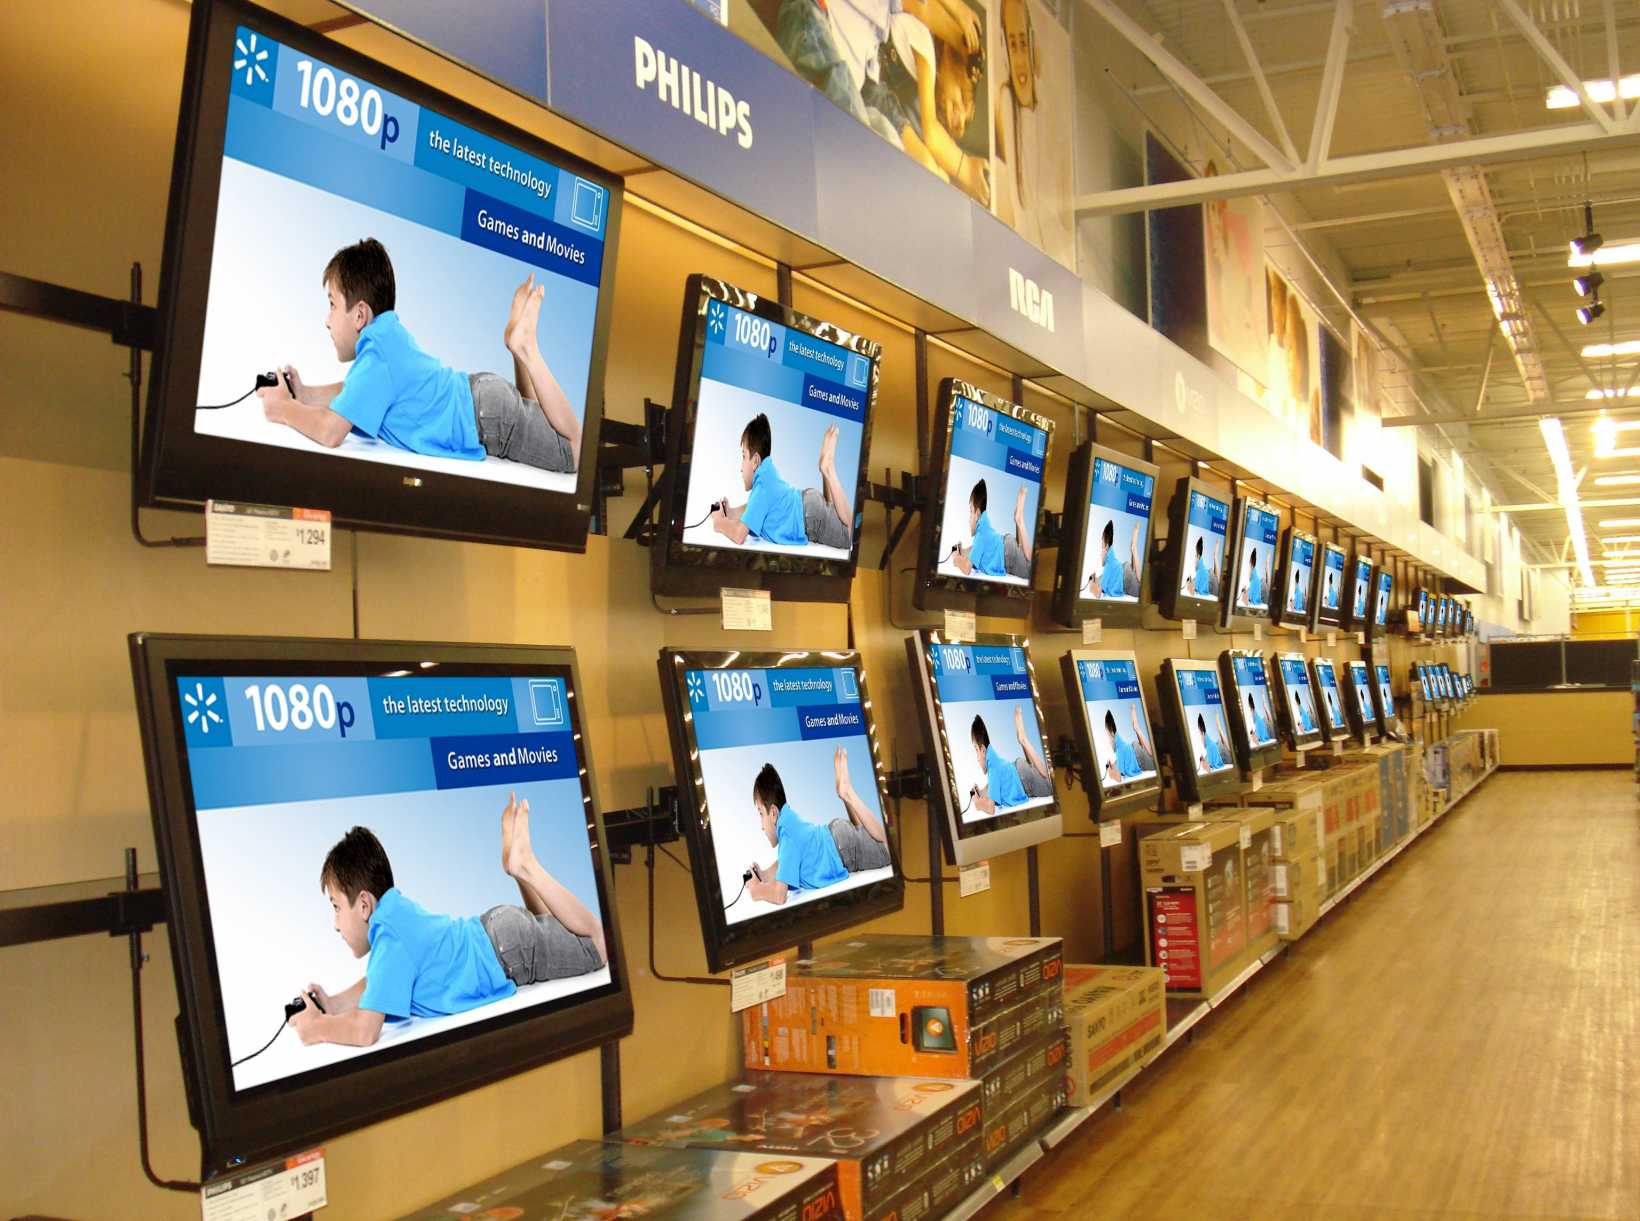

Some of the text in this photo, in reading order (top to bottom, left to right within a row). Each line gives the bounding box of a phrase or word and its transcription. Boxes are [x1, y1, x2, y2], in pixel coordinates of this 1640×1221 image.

[297, 60, 400, 151] 1080p
[634, 35, 753, 149] PHILIPS
[429, 131, 552, 199] the latest technology
[477, 209, 585, 264] Games and Movies
[1009, 267, 1055, 333] RCA
[734, 312, 777, 358] 1080p
[789, 341, 799, 354] the
[809, 385, 828, 401] Games
[828, 389, 840, 403] and
[383, 694, 508, 715] the latest technology
[712, 672, 762, 706] 1080p
[773, 680, 784, 692] the
[784, 679, 801, 692] latest
[244, 683, 356, 737] 1080p
[805, 713, 859, 728] Games and Movies
[447, 746, 558, 770] Games and Movies
